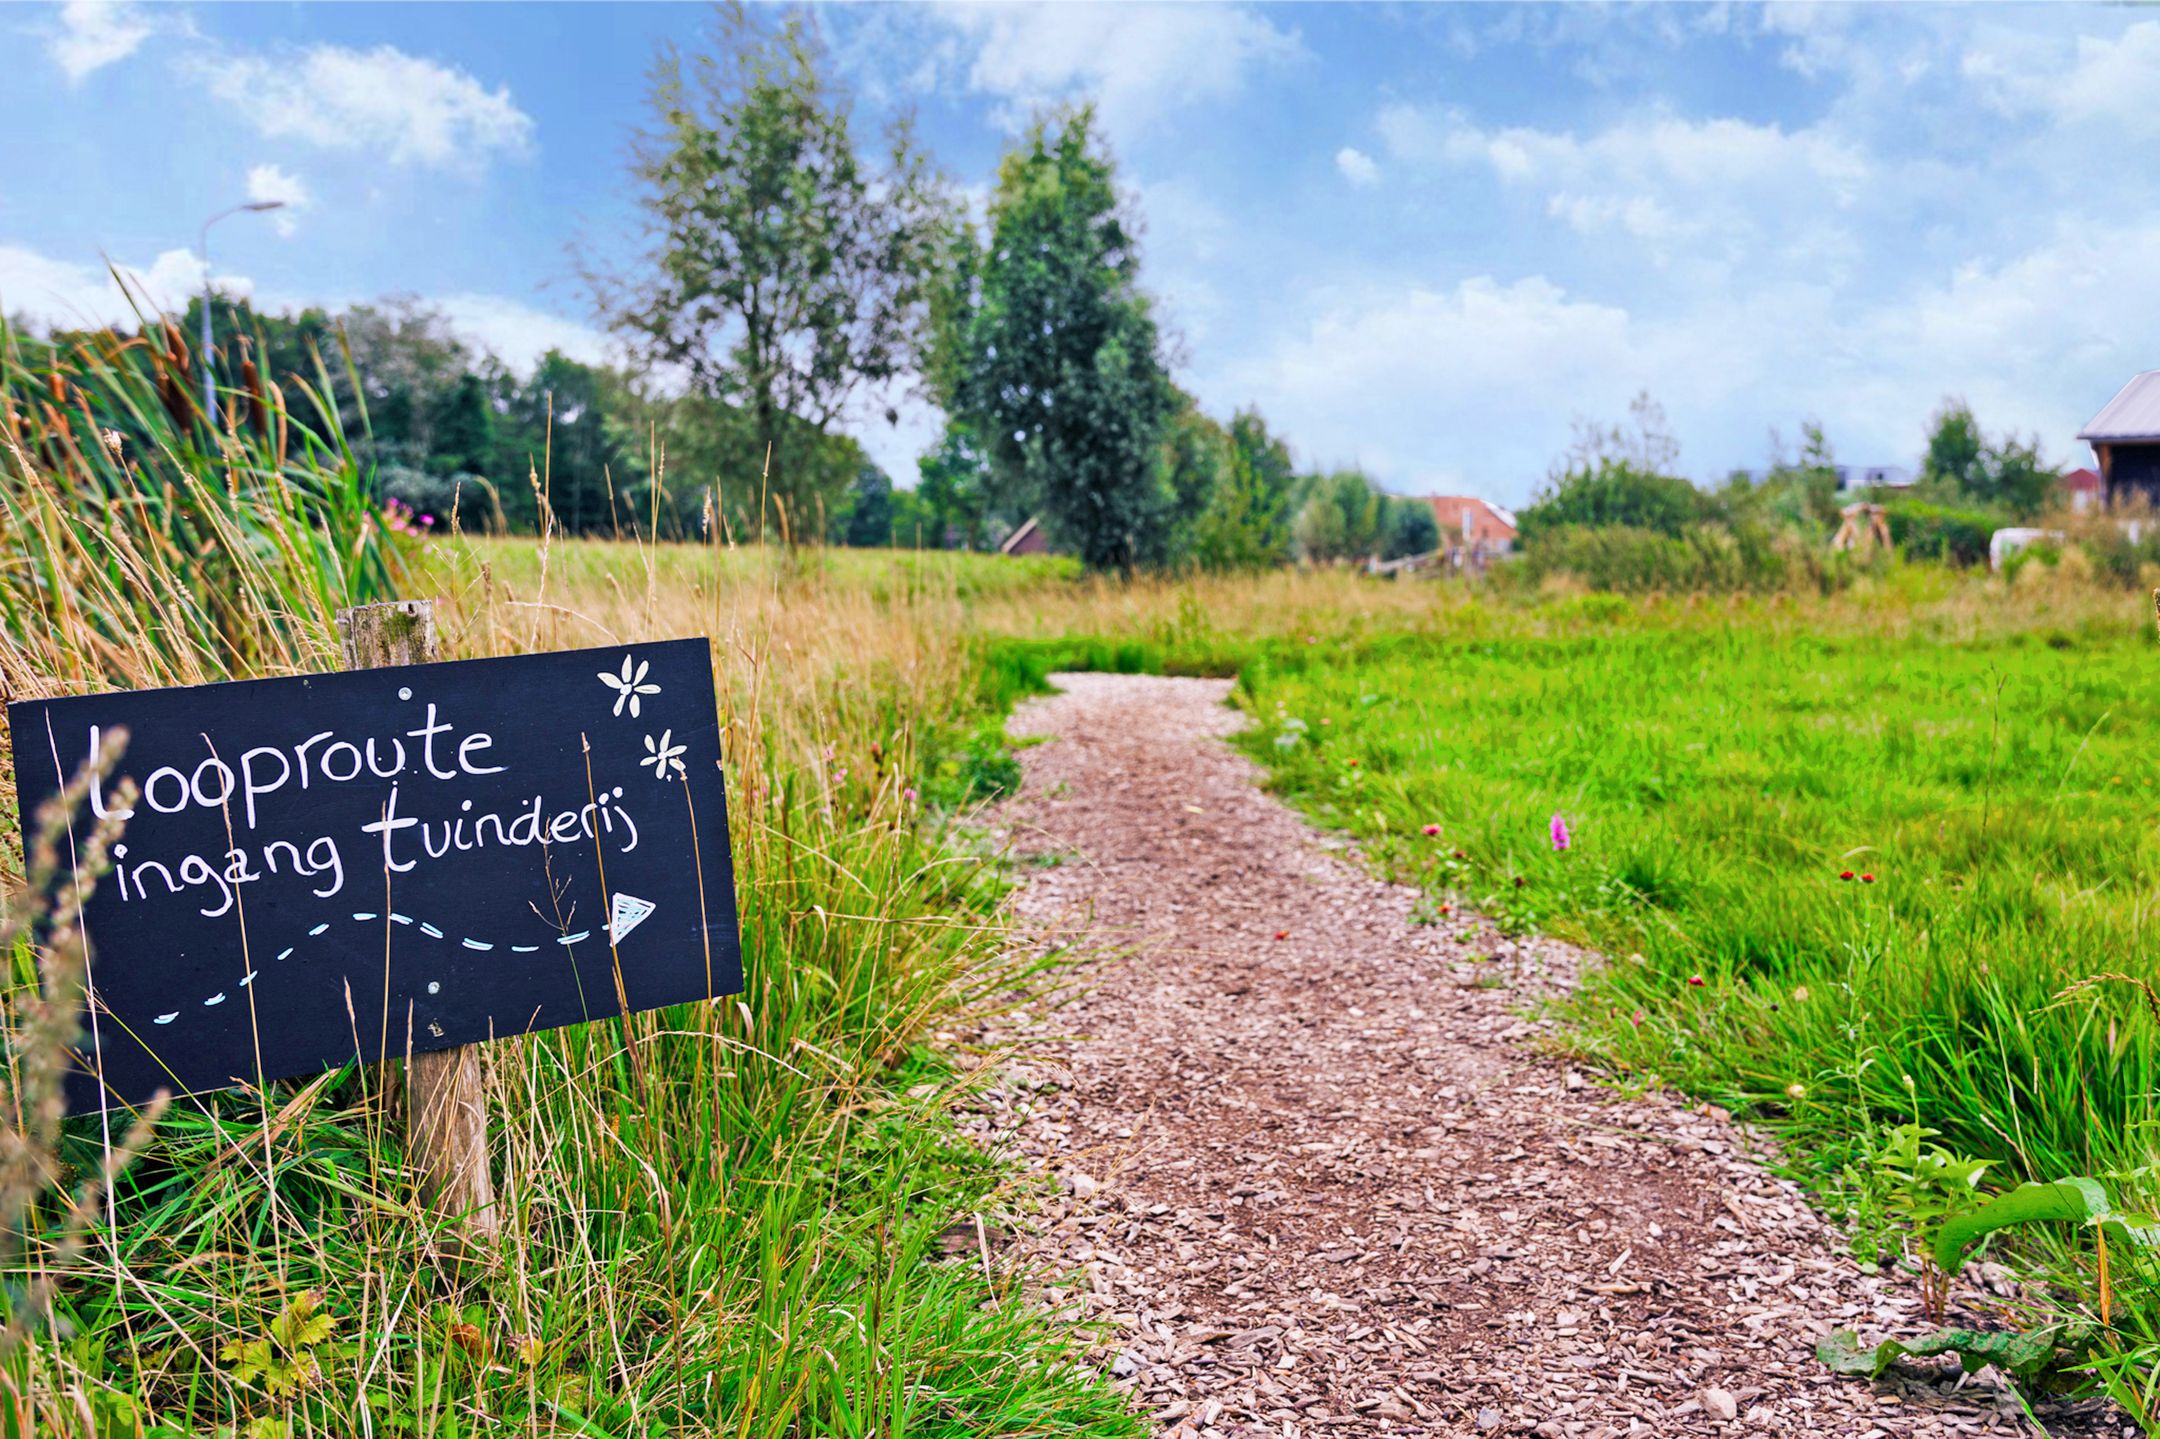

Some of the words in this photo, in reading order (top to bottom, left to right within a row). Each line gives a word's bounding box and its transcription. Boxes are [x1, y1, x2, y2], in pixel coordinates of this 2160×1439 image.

[89, 703, 508, 829] Looproute
[114, 836, 344, 917] ingang
[361, 786, 638, 872] tuinderij
